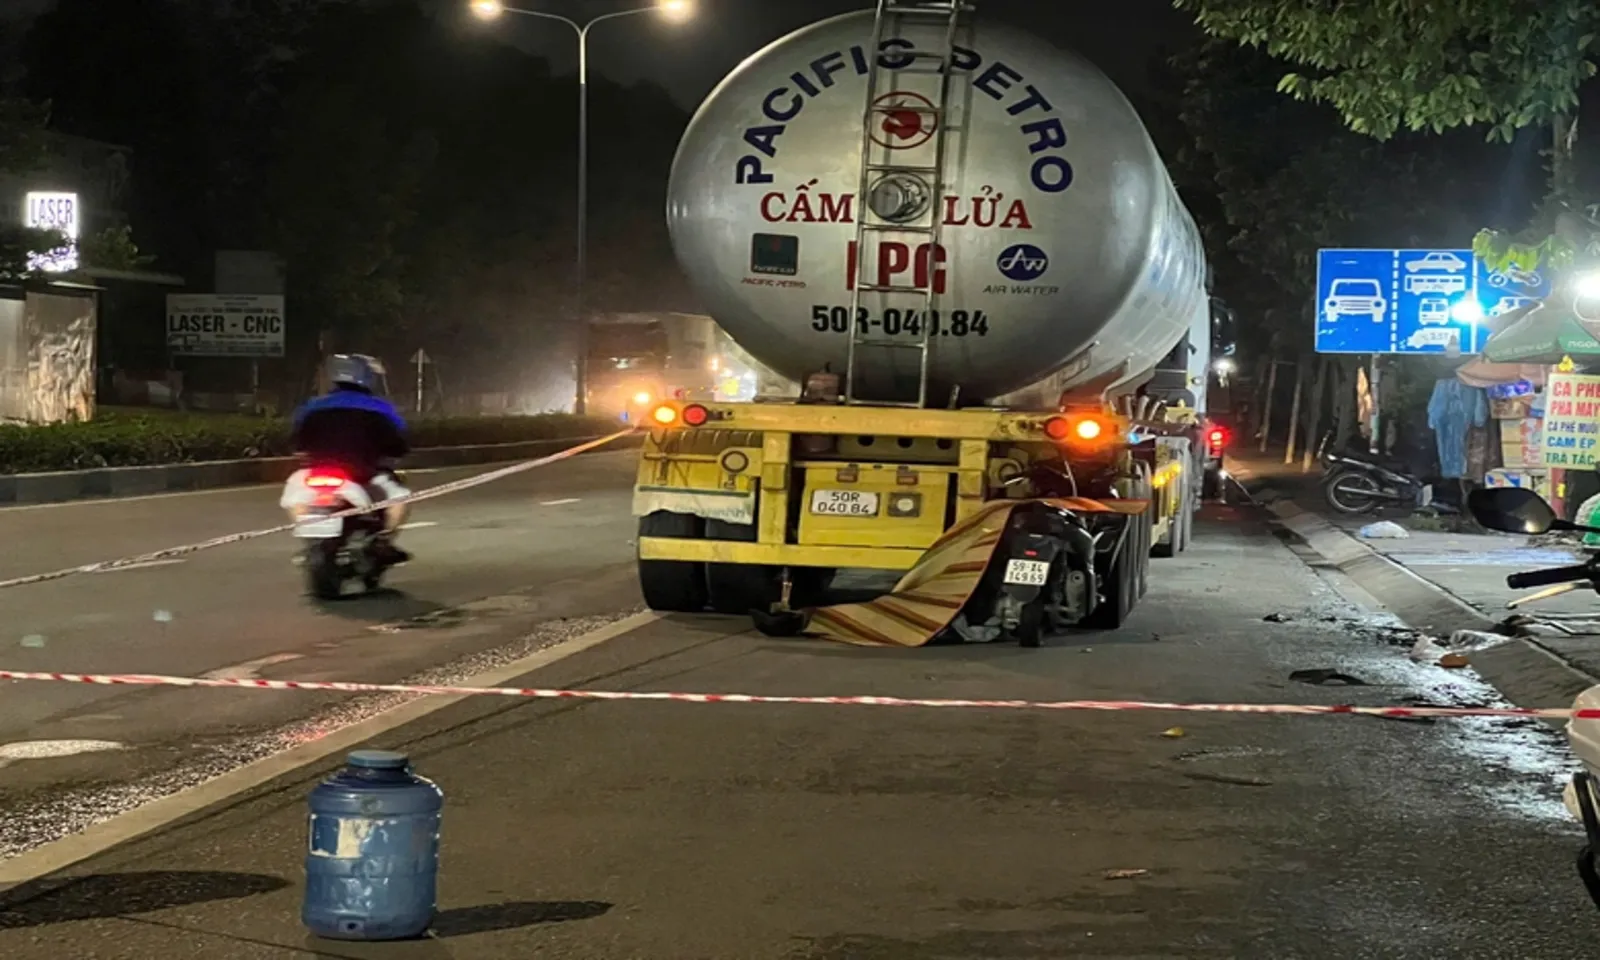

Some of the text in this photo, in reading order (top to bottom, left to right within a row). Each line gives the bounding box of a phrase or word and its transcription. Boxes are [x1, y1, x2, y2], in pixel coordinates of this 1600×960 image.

[735, 38, 1074, 193] PACIFIC PETRO
[30, 198, 73, 224] LASER
[760, 178, 1032, 229] CẤM LỬA
[982, 285, 1060, 296] AIR WATER
[169, 314, 225, 332] LASER
[243, 315, 281, 333] CNC
[1547, 436, 1576, 448] CAM
[831, 491, 860, 502] 50R
